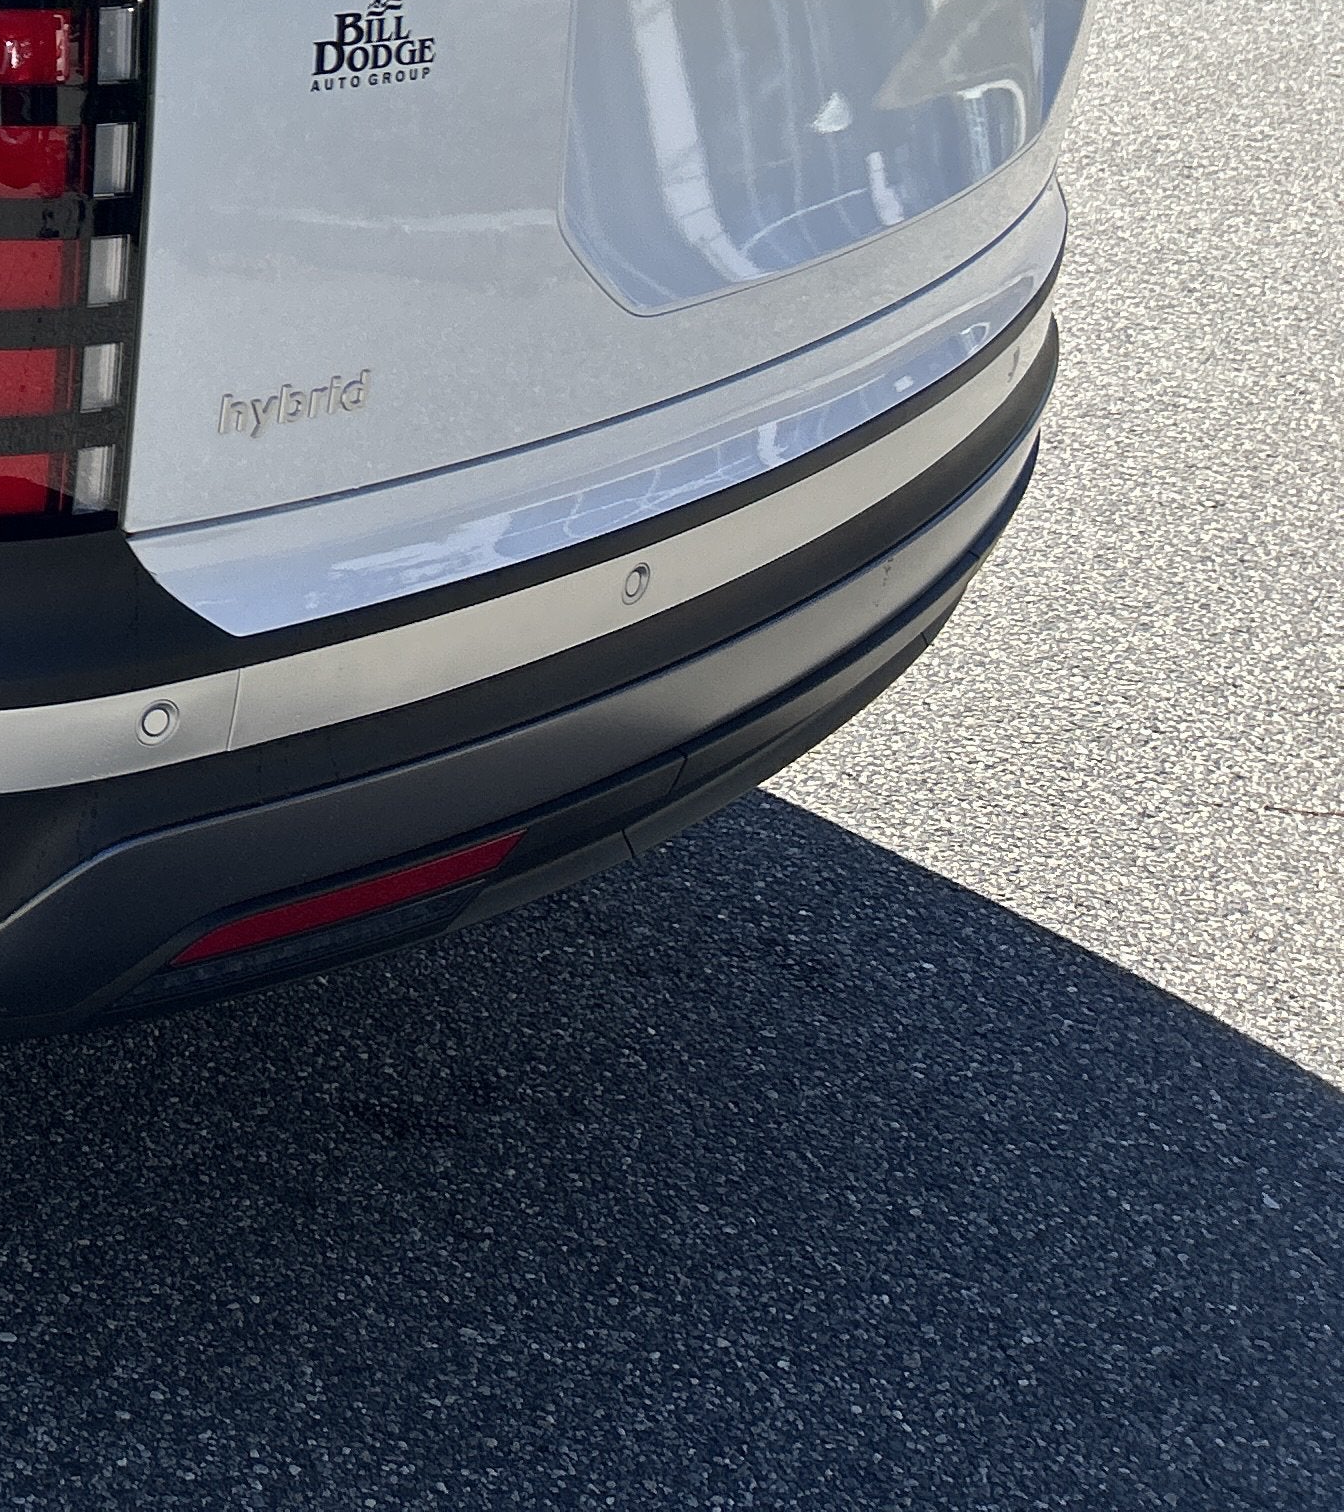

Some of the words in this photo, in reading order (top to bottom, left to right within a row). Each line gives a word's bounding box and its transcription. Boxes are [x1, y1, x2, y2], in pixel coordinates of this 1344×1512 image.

[333, 12, 412, 47] BILL
[312, 37, 437, 76] DODGE
[310, 75, 361, 93] AUTO
[368, 66, 432, 87] GROUP
[217, 368, 372, 439] hybrid
